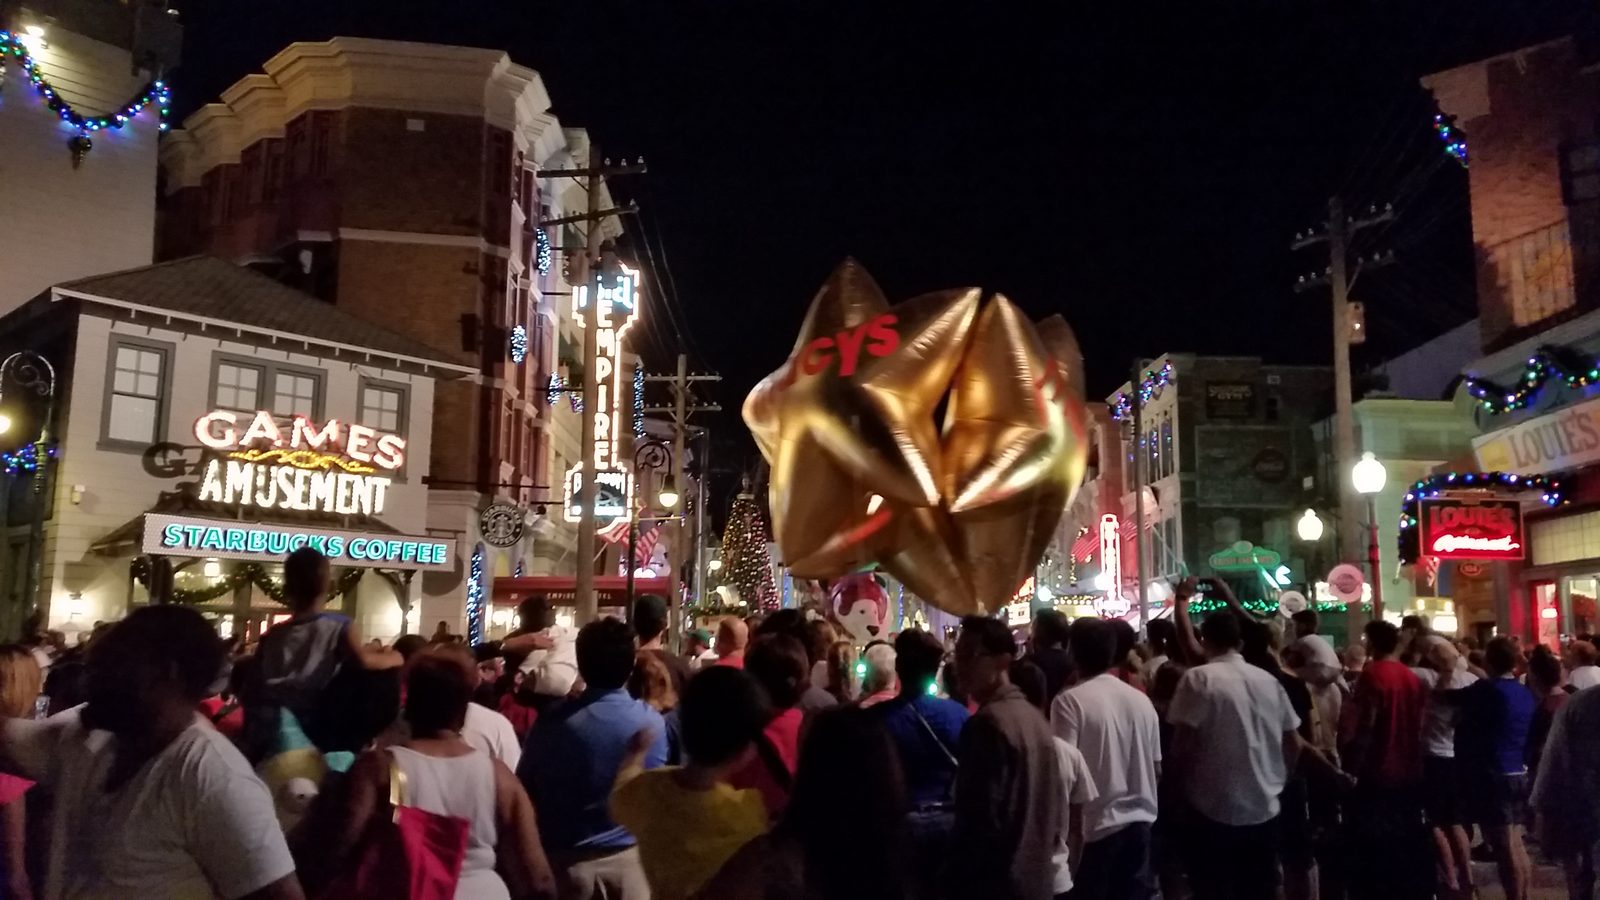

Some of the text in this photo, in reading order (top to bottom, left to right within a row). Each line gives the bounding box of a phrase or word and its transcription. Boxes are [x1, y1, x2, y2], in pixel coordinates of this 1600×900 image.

[594, 299, 616, 470] EMPIRE
[194, 409, 406, 469] GAMES
[199, 459, 391, 515] AMUSEMENT
[163, 524, 447, 563] STARBUCKS COFFEE
